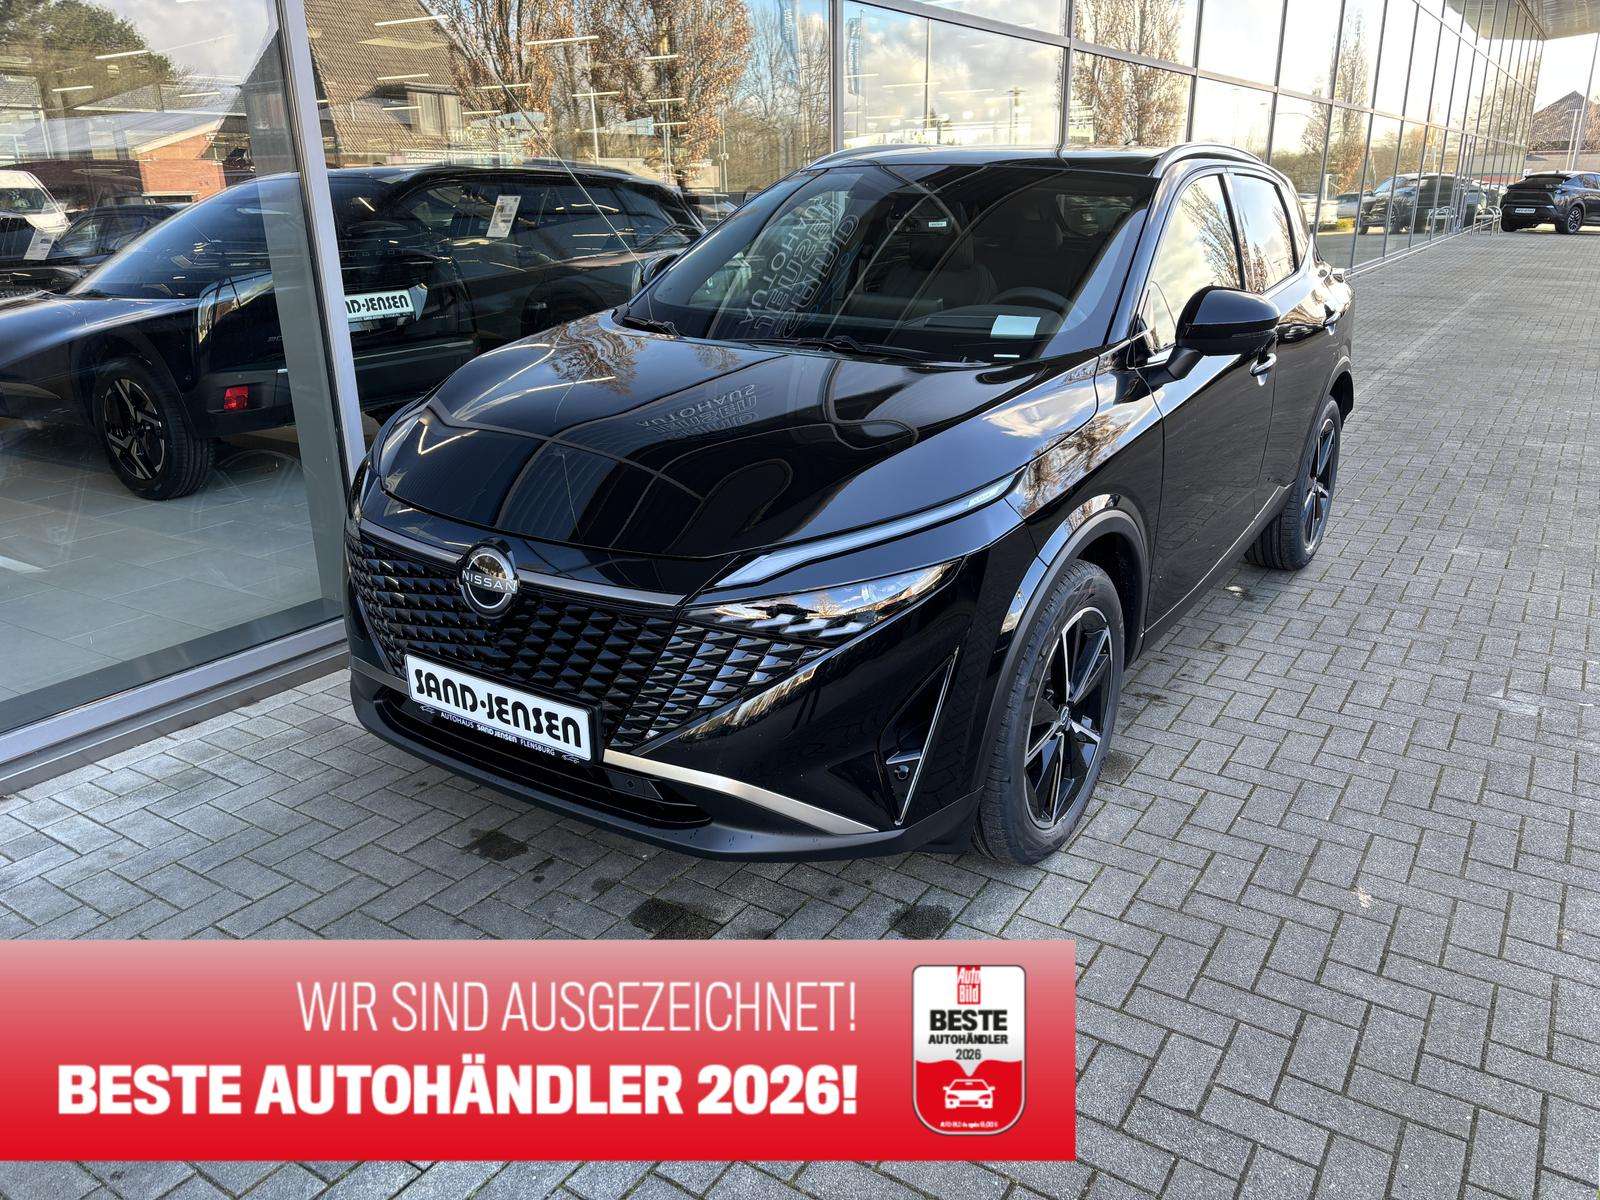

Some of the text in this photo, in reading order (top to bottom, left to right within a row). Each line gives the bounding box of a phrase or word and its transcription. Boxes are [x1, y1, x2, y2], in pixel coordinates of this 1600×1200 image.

[462, 569, 517, 592] NISSAN
[440, 711, 475, 729] AUTOHAUS
[520, 738, 556, 756] FLENSBURG
